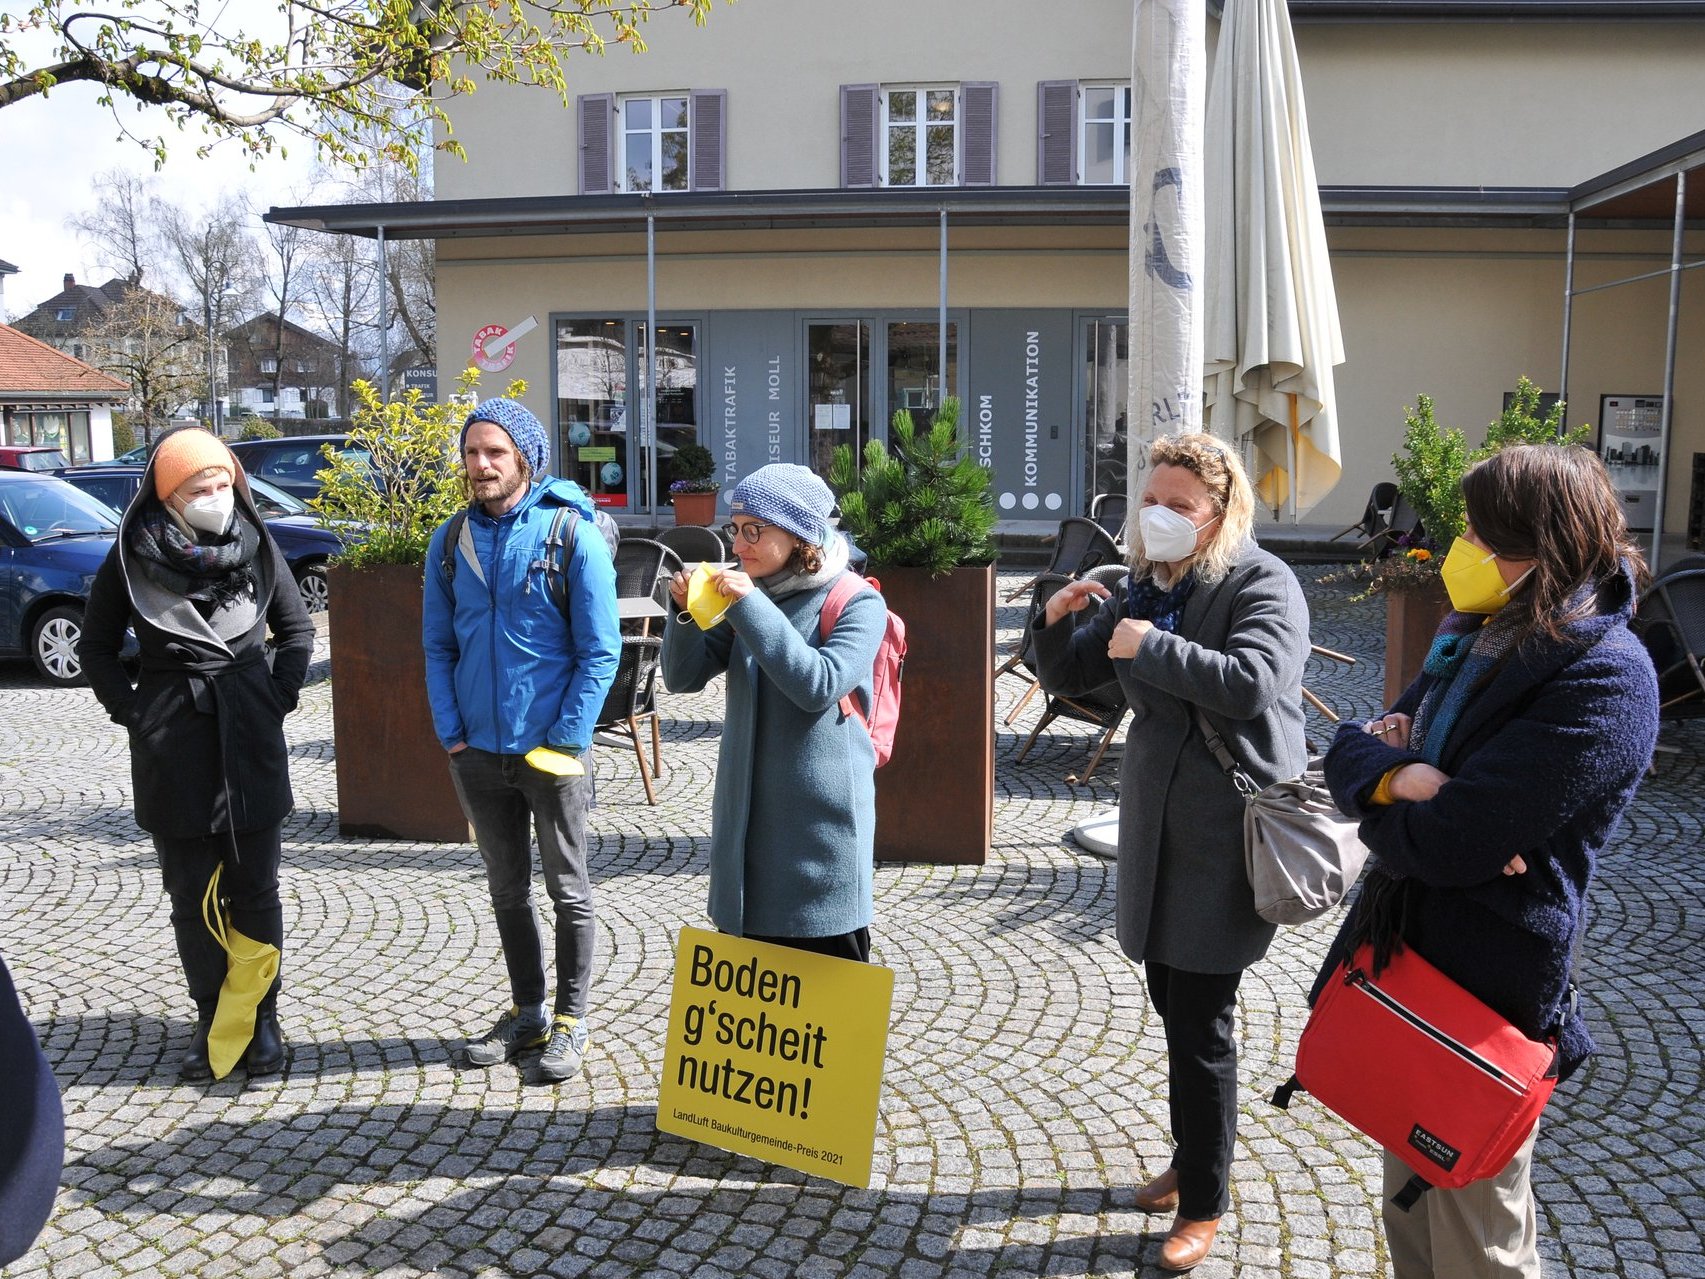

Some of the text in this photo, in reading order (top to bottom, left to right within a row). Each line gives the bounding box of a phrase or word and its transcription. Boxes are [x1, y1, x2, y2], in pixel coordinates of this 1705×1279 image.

[474, 327, 503, 354] TABAK
[768, 355, 780, 400] MOLL
[725, 366, 737, 482] TABAKTRAFIK
[1024, 331, 1040, 487] KOMMUNIKATION
[690, 944, 802, 1009] Boden
[677, 1054, 812, 1120] nutzen!
[672, 1108, 843, 1166] LandLuft Baukulturgemeinde-Preis 2021
[1415, 1129, 1454, 1158] EASTSUN
